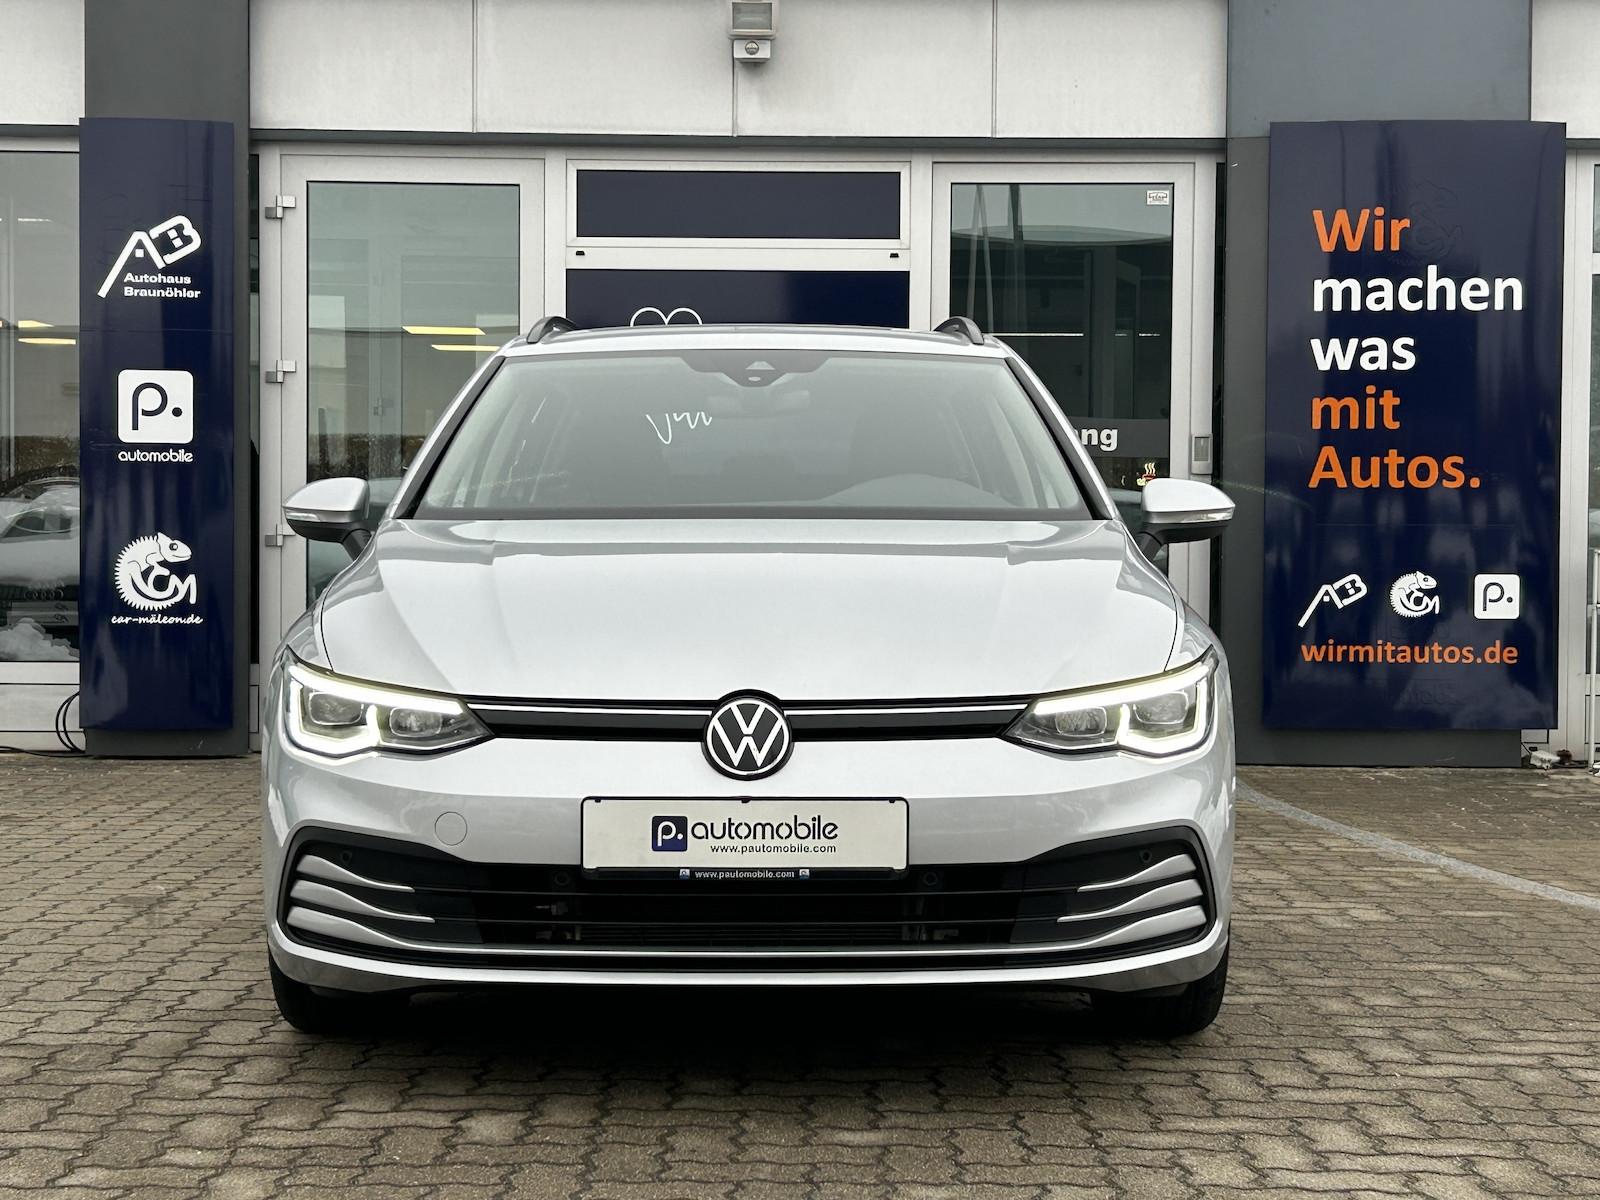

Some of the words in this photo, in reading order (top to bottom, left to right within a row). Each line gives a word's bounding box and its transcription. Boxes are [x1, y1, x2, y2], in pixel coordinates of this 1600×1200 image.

[1312, 206, 1411, 253] Wir
[123, 272, 192, 284] Autohaus
[1313, 265, 1523, 312] machen
[123, 286, 201, 298] Braunöhler
[1310, 336, 1417, 371] was
[1311, 384, 1401, 430] mit
[117, 449, 194, 462] automobile
[1308, 445, 1481, 489] Autos.
[1300, 639, 1519, 665] wirmitautos.de
[690, 814, 839, 840] automobile
[710, 843, 837, 855] www.pautomobile.com
[694, 869, 795, 880] www.pautomobile.com
